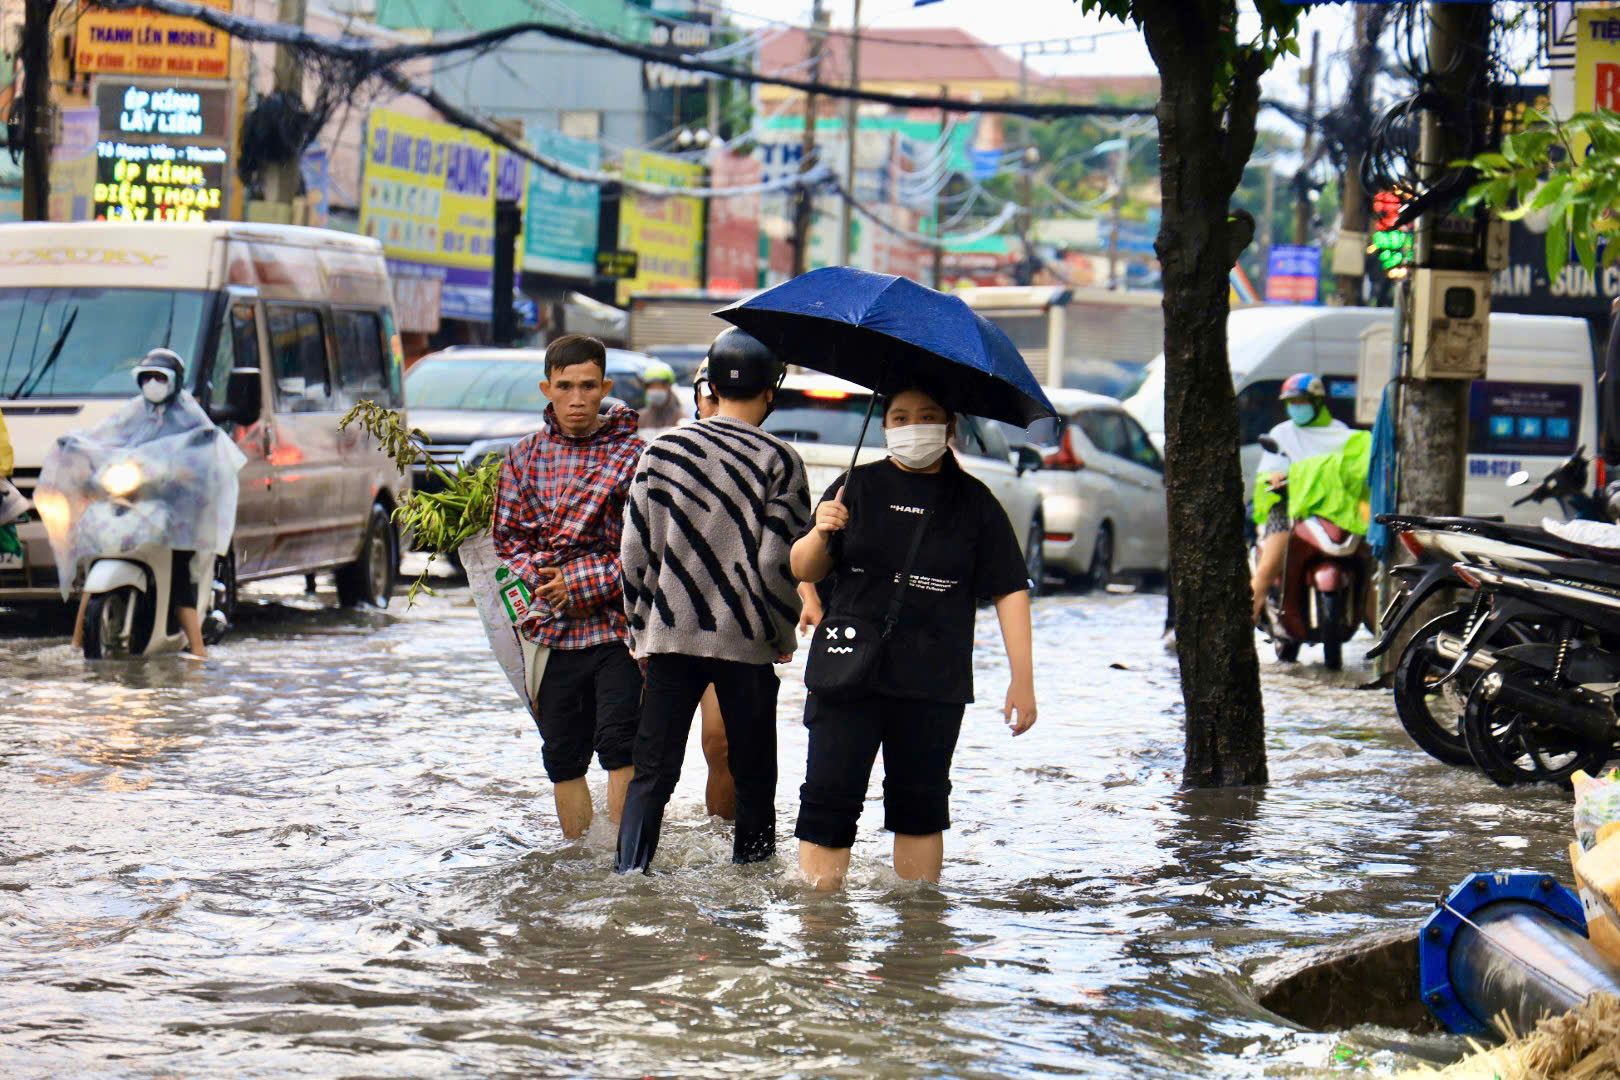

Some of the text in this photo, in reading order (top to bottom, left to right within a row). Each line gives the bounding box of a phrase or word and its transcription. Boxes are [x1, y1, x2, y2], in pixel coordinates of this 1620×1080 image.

[89, 26, 132, 43] THANH
[167, 29, 216, 48] MOBILE
[124, 86, 200, 113] ÉP KÍNH
[114, 157, 203, 185] ÉP KÍNH
